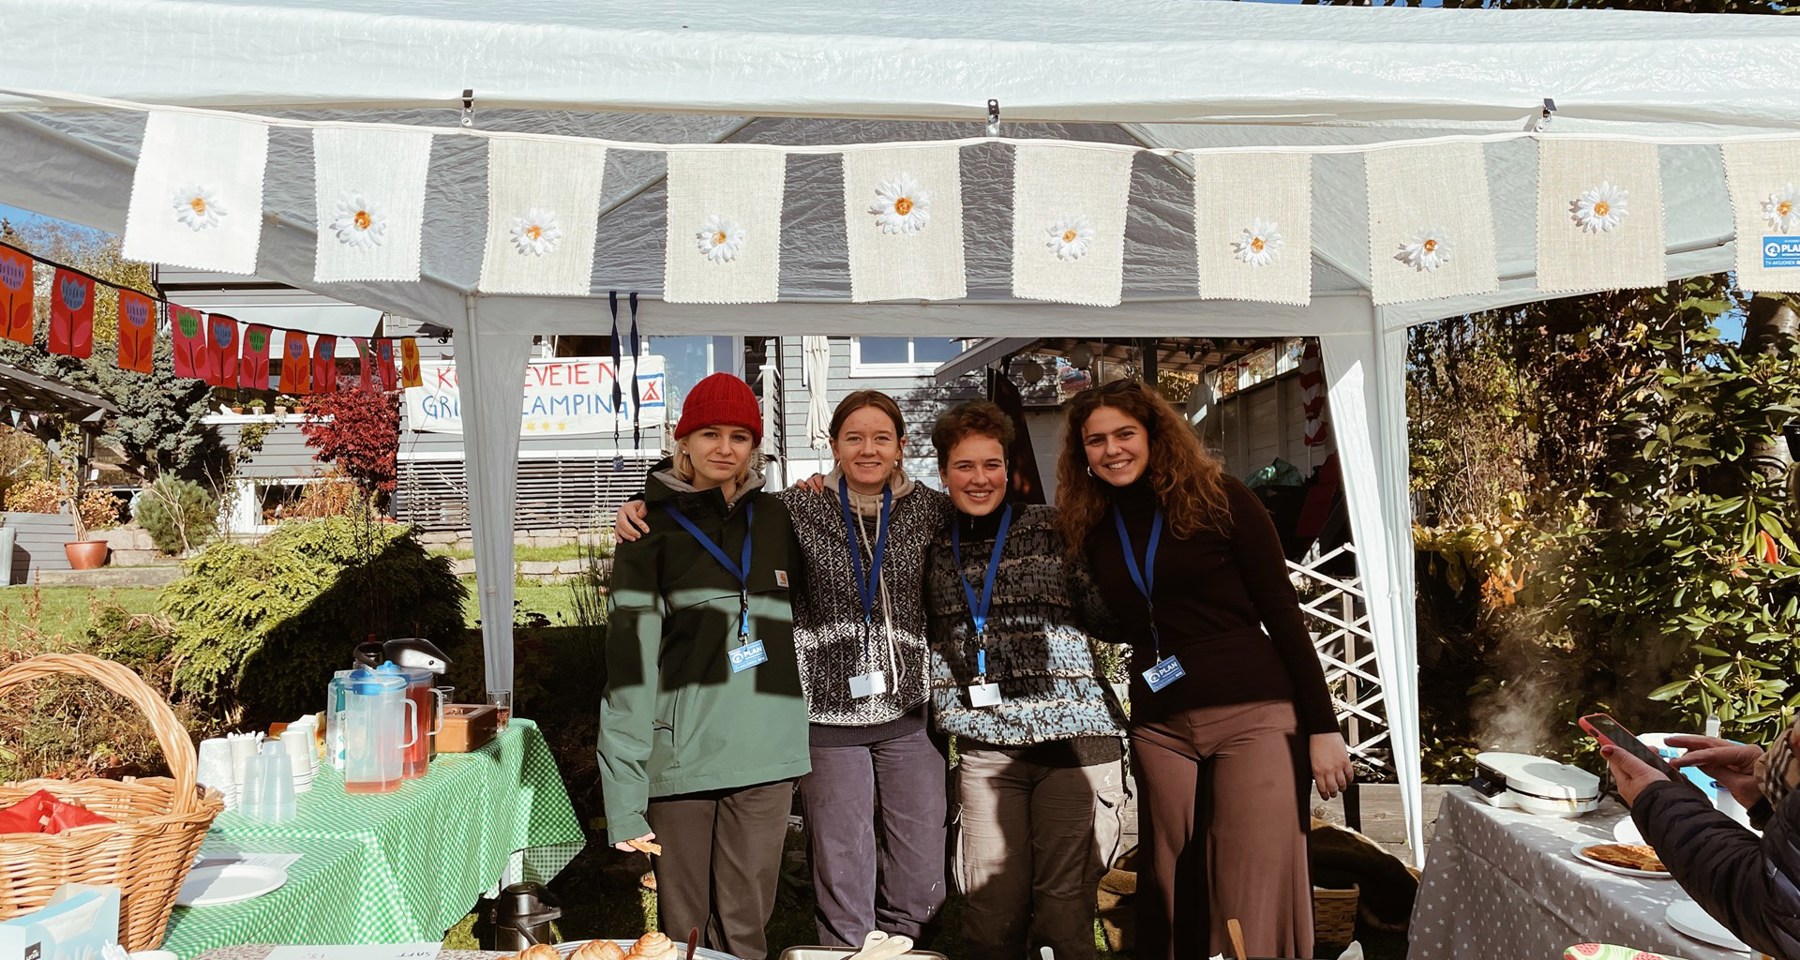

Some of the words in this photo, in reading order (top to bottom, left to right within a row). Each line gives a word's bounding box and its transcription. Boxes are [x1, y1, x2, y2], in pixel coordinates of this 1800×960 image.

[1781, 244, 1800, 253] PLA
[743, 646, 763, 658] PLAN
[1159, 661, 1178, 676] PLAN
